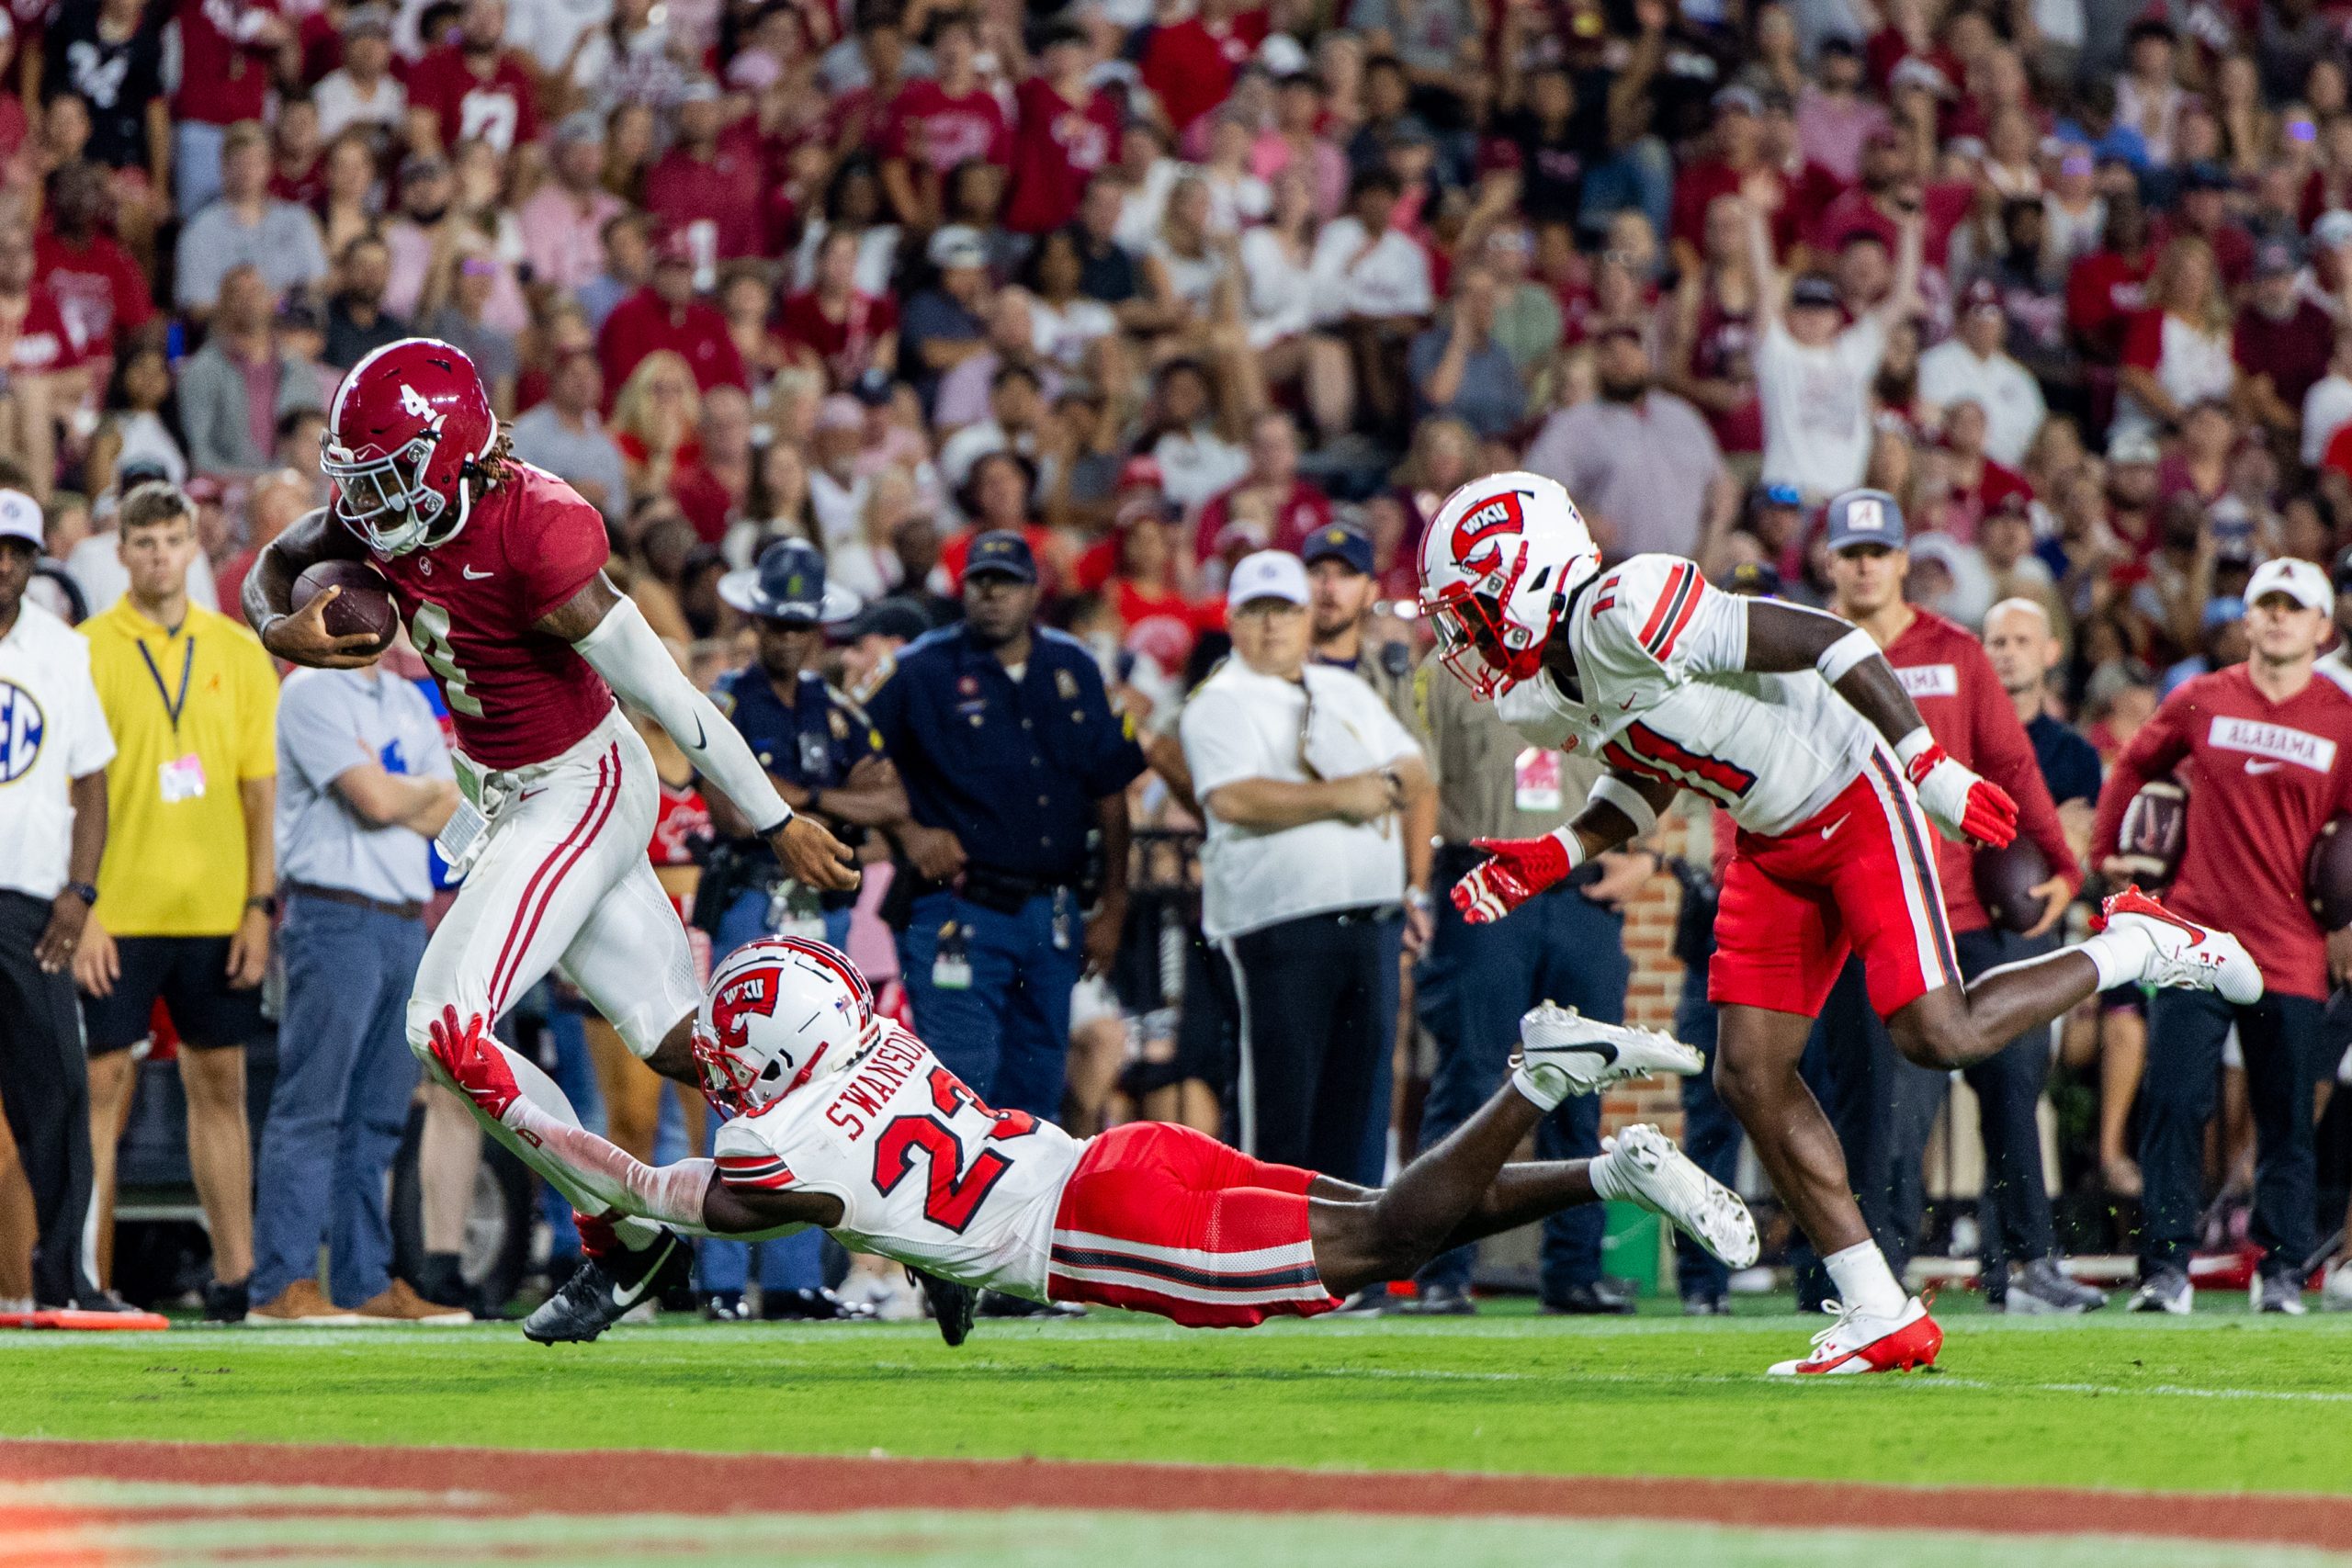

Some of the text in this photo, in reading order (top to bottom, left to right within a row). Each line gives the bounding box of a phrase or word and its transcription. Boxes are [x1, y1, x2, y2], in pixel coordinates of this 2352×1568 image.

[400, 384, 437, 423] 4
[1461, 502, 1510, 536] WKU
[412, 598, 486, 718] 4
[2228, 725, 2317, 760] ALABAMA
[1602, 719, 1758, 808] 11
[723, 978, 764, 1006] WKU
[871, 1066, 1042, 1235] 23
